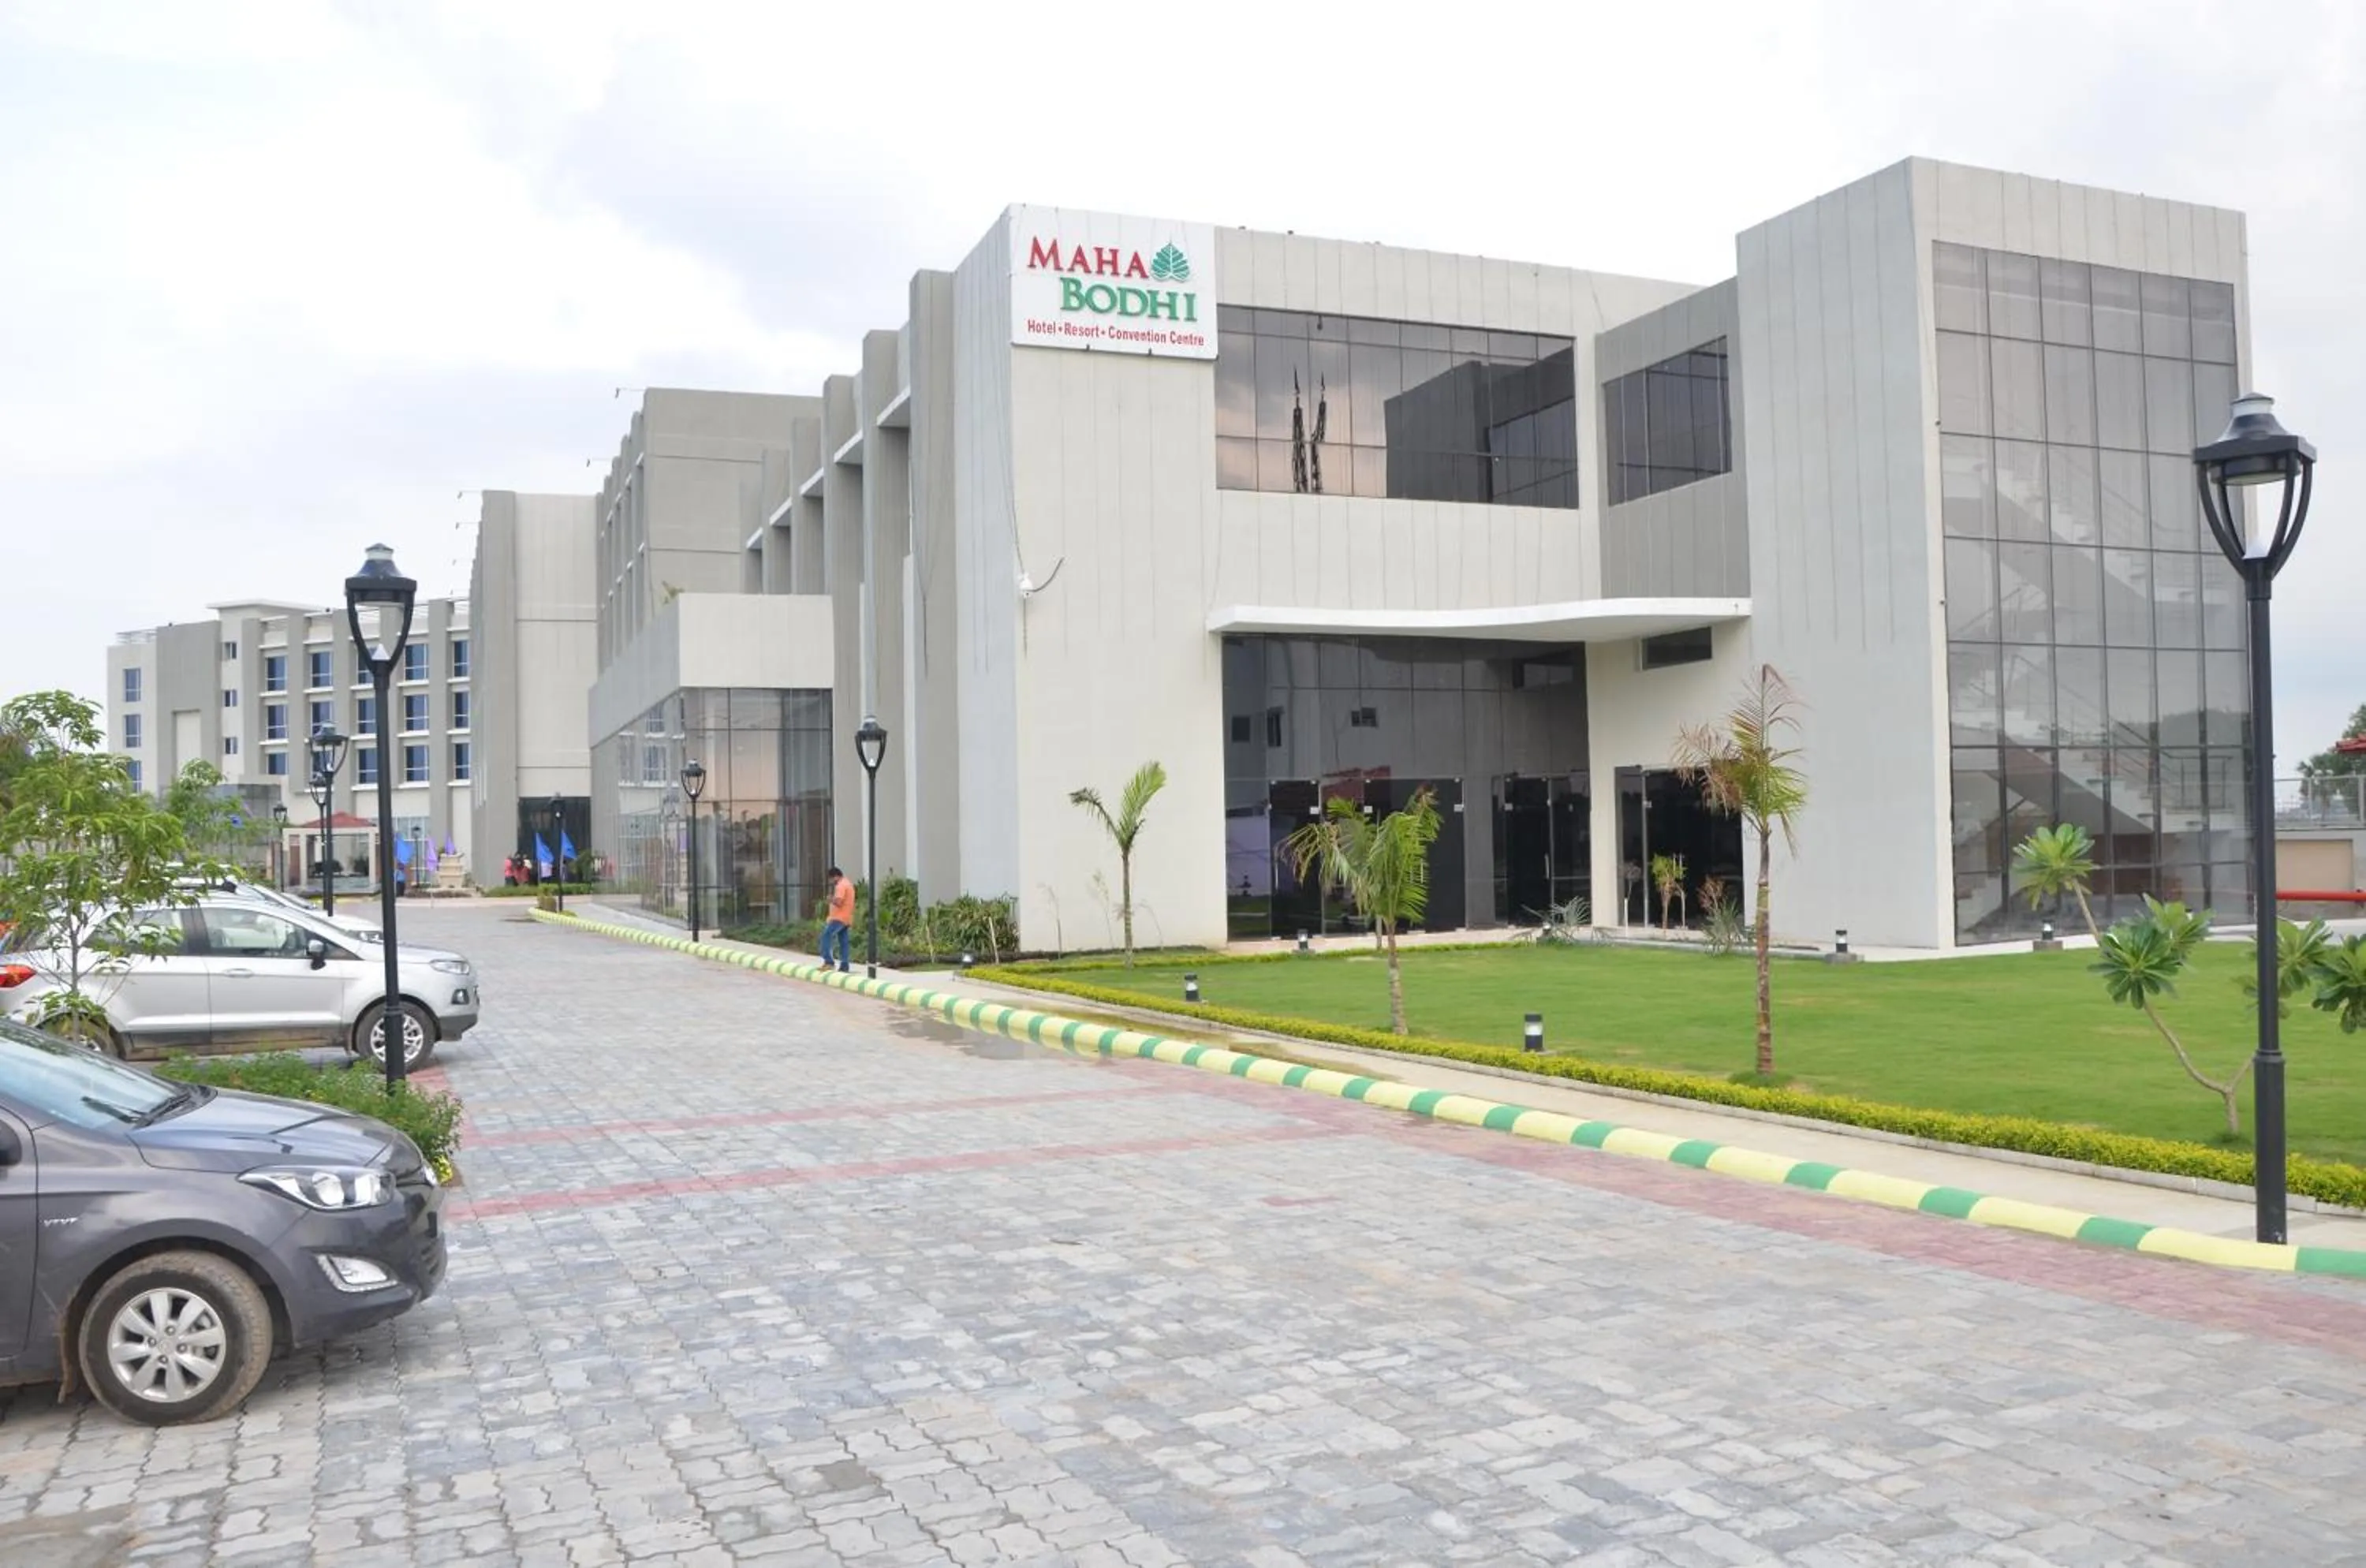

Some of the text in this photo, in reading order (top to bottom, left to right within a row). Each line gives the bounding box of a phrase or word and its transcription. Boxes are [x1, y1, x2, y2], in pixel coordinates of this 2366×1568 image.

[1028, 235, 1149, 278] MAHA
[1059, 277, 1197, 322] BODHI
[1028, 319, 1204, 345] Hotel Resort Convention Centre
